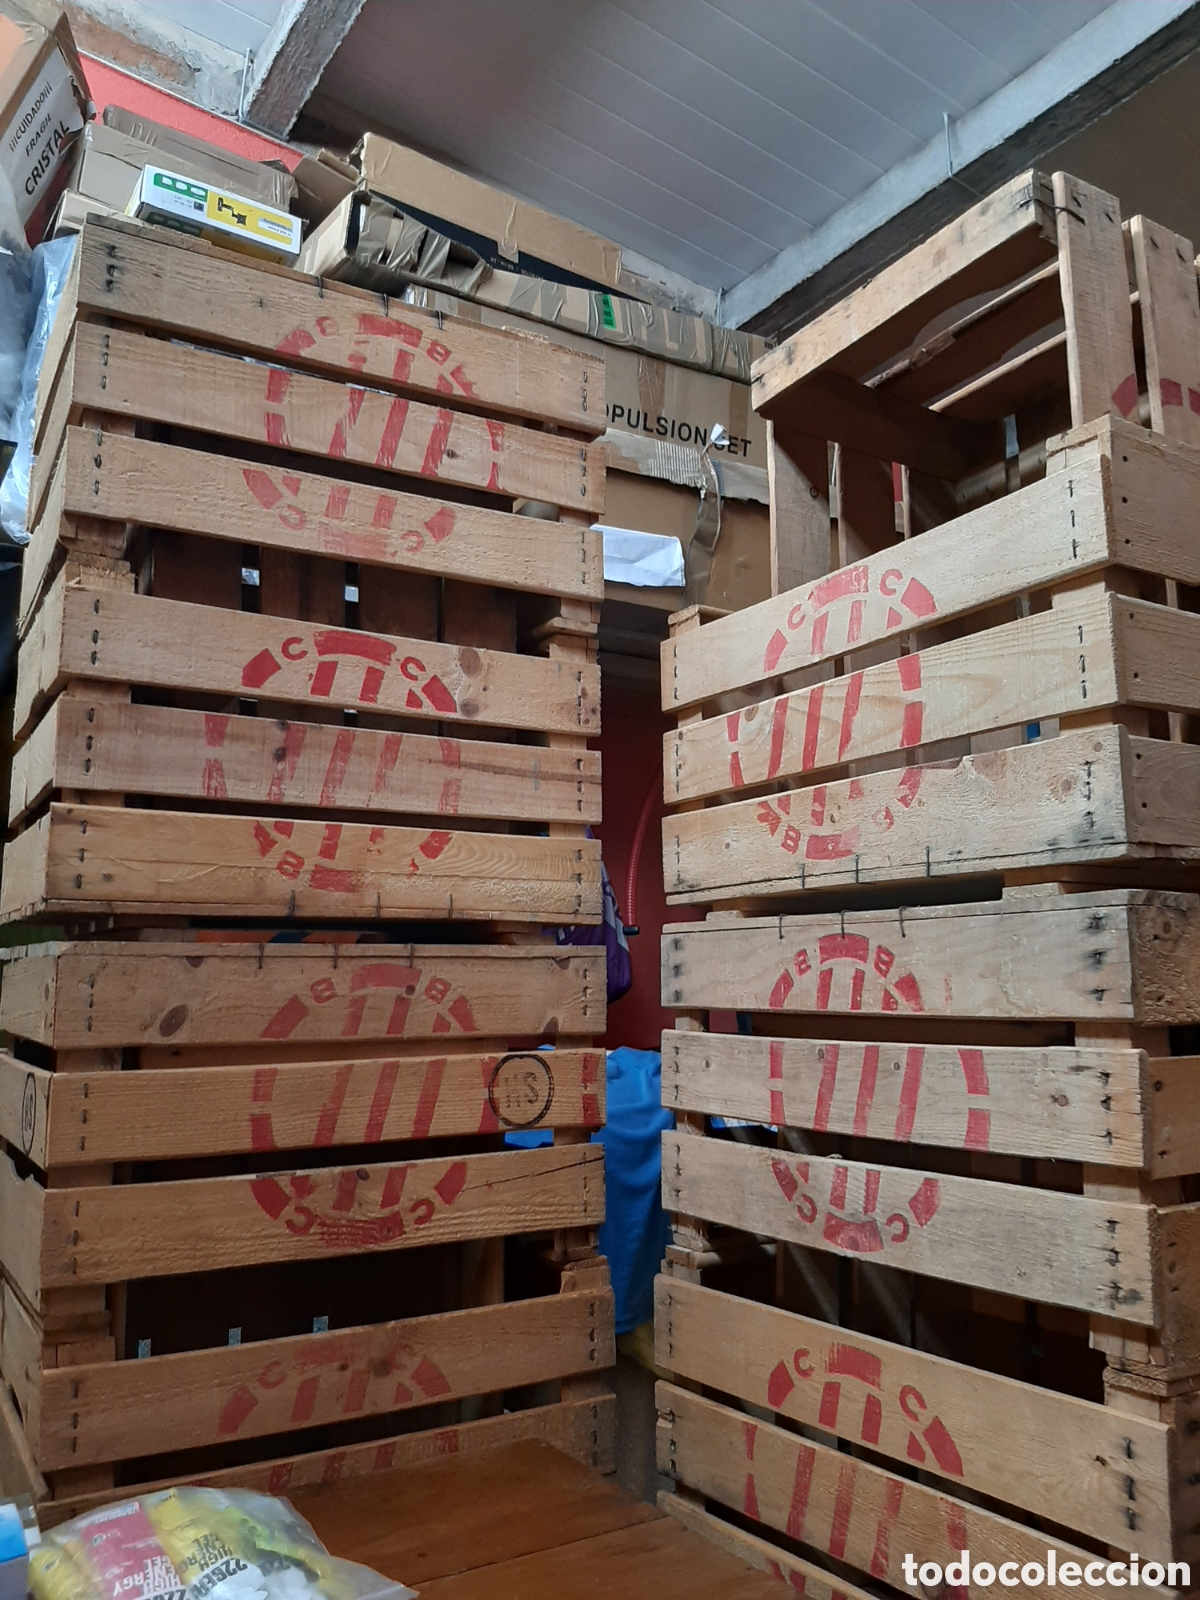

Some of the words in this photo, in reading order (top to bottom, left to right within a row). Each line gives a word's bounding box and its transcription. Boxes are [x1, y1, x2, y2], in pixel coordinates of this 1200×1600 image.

[25, 112, 52, 157] FRAGIL
[24, 120, 70, 195] CRISTAL
[606, 403, 709, 447] PULSION
